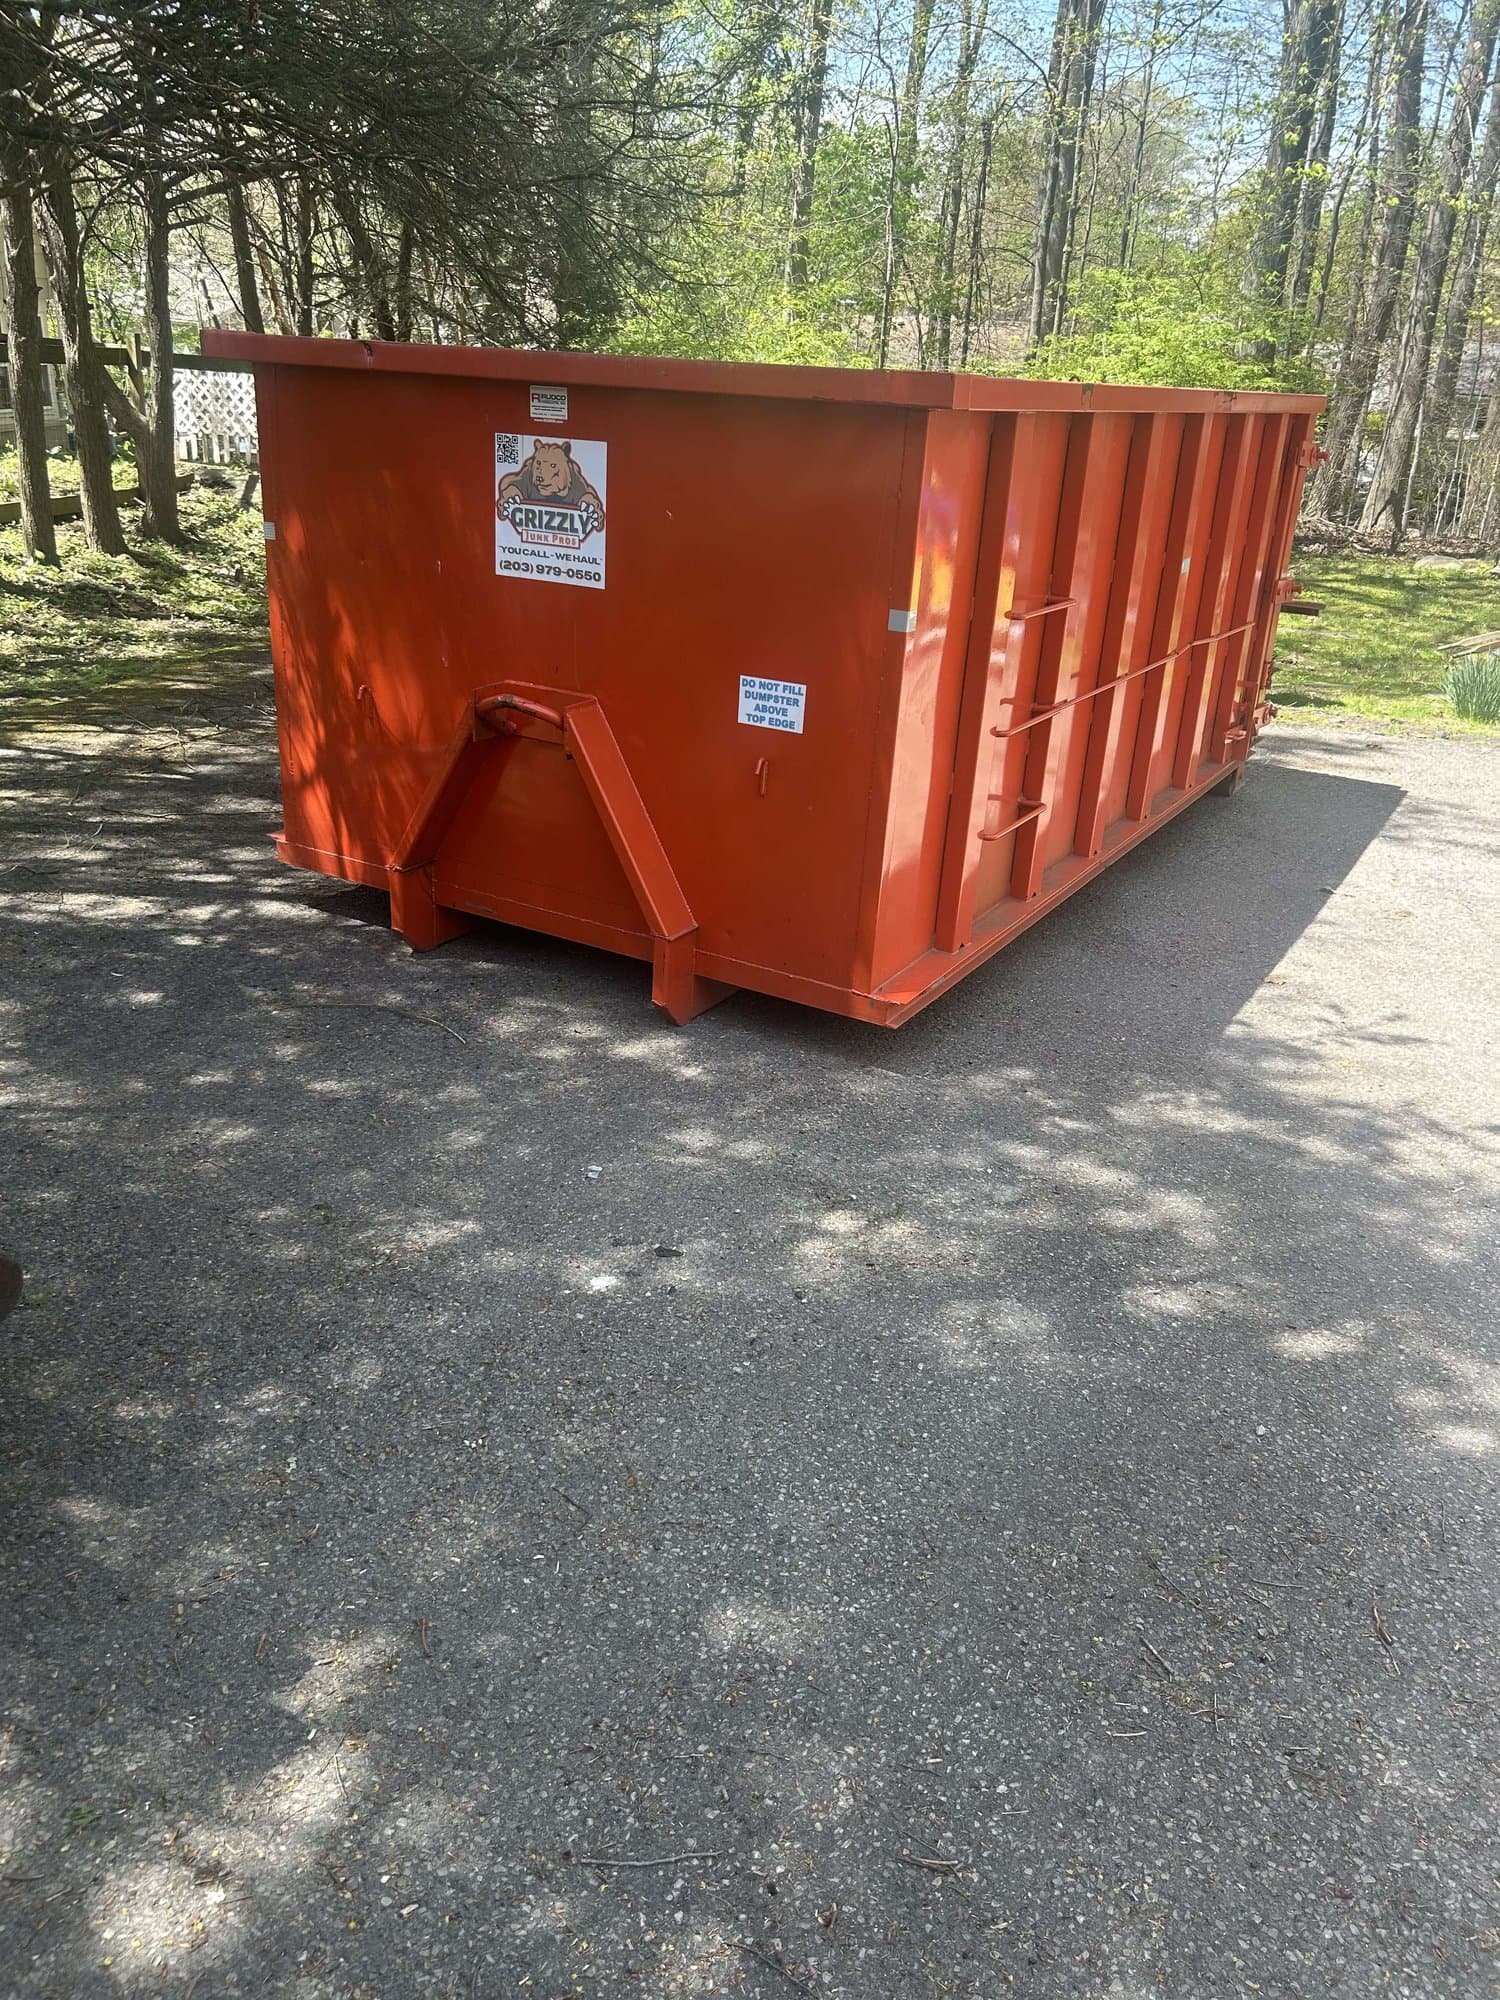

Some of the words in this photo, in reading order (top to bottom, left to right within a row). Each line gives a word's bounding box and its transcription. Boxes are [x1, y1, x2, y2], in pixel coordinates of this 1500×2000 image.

[511, 507, 592, 534] GRIZZLY
[525, 530, 549, 542] JUNK
[552, 534, 577, 545] PROS
[522, 548, 549, 558] CALL
[555, 552, 572, 561] WE
[499, 560, 534, 574] (203)
[536, 564, 602, 582] 979-0550
[742, 678, 756, 688] DO
[758, 680, 780, 692] NOT
[783, 684, 804, 696] FILL
[744, 690, 800, 707] DUMPSTER
[754, 703, 788, 717] ABOVE
[746, 713, 766, 724] TOP
[768, 716, 796, 730] EDGE
